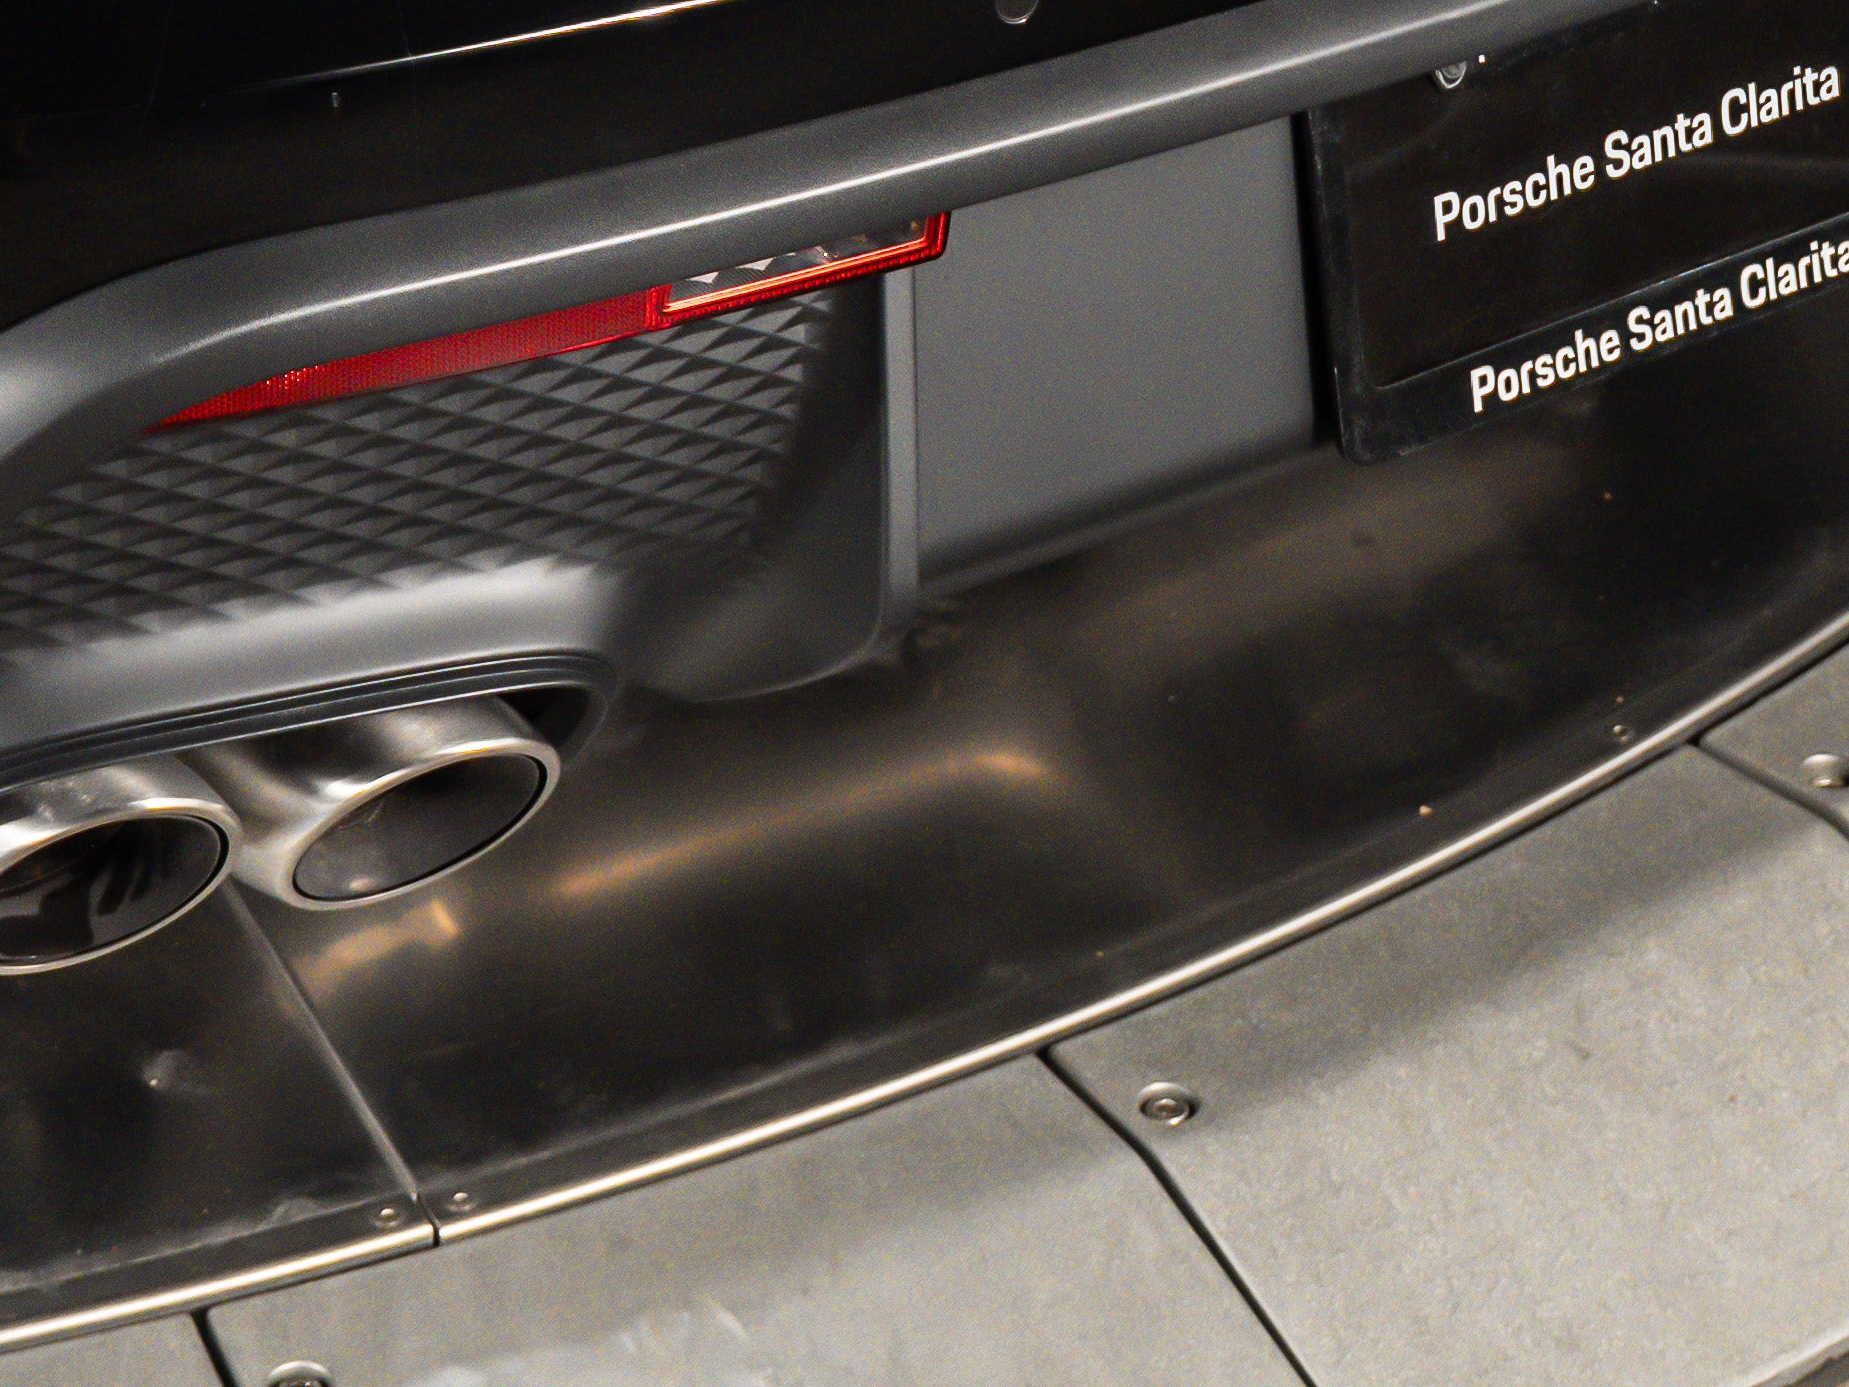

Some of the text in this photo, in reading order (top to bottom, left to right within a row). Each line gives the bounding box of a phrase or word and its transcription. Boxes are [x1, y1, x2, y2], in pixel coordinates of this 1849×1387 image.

[1432, 65, 1841, 242] Porsche Santa Clarita
[1469, 328, 1622, 414] Porsche
[1626, 287, 1735, 352] Santa
